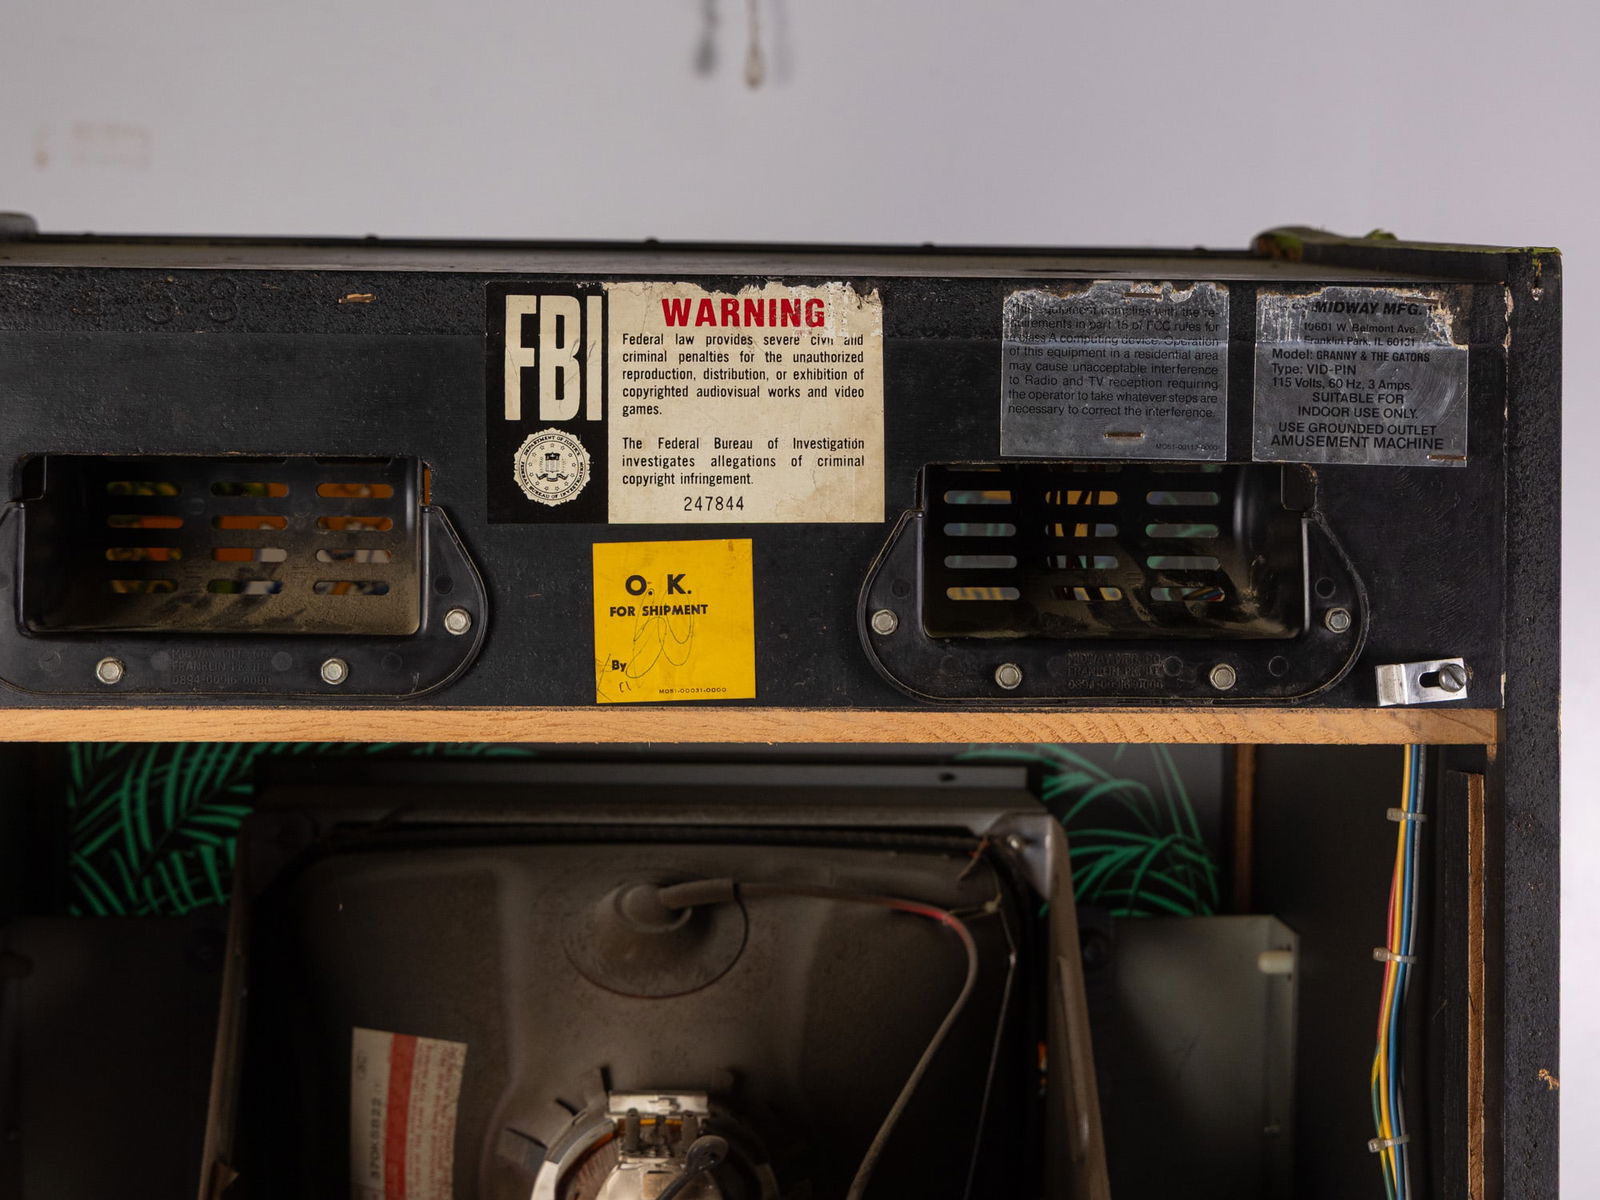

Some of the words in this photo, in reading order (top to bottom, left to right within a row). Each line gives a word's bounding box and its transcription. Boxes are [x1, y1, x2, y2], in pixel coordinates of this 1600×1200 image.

[662, 298, 825, 327] WARNING
[1314, 301, 1378, 315] MIDWAY
[1383, 302, 1423, 316] MFG.
[1076, 320, 1086, 329] in
[1090, 320, 1111, 331] part
[1133, 321, 1144, 330] of
[1147, 322, 1170, 331] FCC
[1175, 322, 1201, 331] rules
[1205, 323, 1218, 331] for
[1337, 323, 1348, 332] W.
[1352, 324, 1393, 333] Belmont
[1398, 325, 1418, 334] Ave.
[622, 333, 663, 346] Federal
[675, 333, 694, 346] law
[706, 333, 753, 349] provides
[764, 336, 799, 346] severe
[1049, 334, 1057, 343] A
[1060, 336, 1118, 346] computing
[1374, 337, 1383, 346] IL
[505, 295, 603, 421] FBI
[622, 351, 666, 364] criminal
[679, 351, 729, 366] penalties
[740, 351, 754, 364] for
[765, 351, 782, 364] the
[793, 351, 864, 364] unauthorized
[1009, 348, 1021, 356] of
[1024, 348, 1043, 356] this
[1047, 349, 1106, 359] equipment
[1110, 350, 1119, 358] in
[1135, 349, 1191, 359] residential
[1195, 352, 1218, 360] area
[1272, 349, 1313, 360] Model:
[1317, 352, 1357, 361] GRANNY
[1361, 352, 1367, 361] &
[1372, 352, 1389, 361] THE
[1392, 353, 1430, 362] GATORS
[622, 368, 696, 383] reproduction,
[703, 368, 769, 383] distribution,
[776, 371, 786, 381] or
[793, 368, 847, 381] exhibition
[853, 368, 864, 381] of
[1009, 363, 1031, 373] may
[1036, 363, 1068, 372] cause
[1073, 363, 1147, 374] unacceptable
[1151, 365, 1218, 374] interference
[1272, 364, 1303, 375] Type:
[1307, 364, 1356, 375] VID-PIN
[1009, 376, 1019, 384] to
[1026, 376, 1057, 386] Radio
[1063, 376, 1083, 386] and
[1089, 377, 1104, 386] TV
[1109, 377, 1162, 389] reception
[1167, 379, 1218, 391] requiring
[1272, 377, 1291, 387] 115
[1295, 378, 1325, 389] Volts,
[1329, 379, 1342, 388] 60
[1346, 380, 1364, 390] Hz,
[1369, 380, 1375, 389] 3
[1378, 381, 1412, 391] Amps.
[622, 386, 688, 400] copyrighted
[697, 386, 760, 398] audiovisual
[768, 386, 800, 398] works
[807, 386, 827, 398] and
[835, 386, 864, 398] video
[1009, 390, 1025, 399] the
[1029, 391, 1074, 402] operator
[1077, 392, 1088, 400] to
[1091, 391, 1113, 401] take
[1117, 392, 1167, 402] whatever
[1169, 393, 1197, 404] steps
[1313, 392, 1373, 403] SUITABLE
[1378, 394, 1404, 403] FOR
[622, 405, 662, 418] games.
[1009, 405, 1064, 415] necessary
[1068, 405, 1078, 414] to
[1082, 406, 1120, 415] correct
[1125, 406, 1141, 416] the
[1145, 407, 1215, 418] interference.
[1298, 407, 1349, 417] INDOOR
[1354, 408, 1379, 418] USE
[1384, 409, 1418, 419] ONLY.
[1279, 423, 1304, 432] USE
[1309, 424, 1384, 434] GROUNDED
[1388, 425, 1437, 435] OUTLET
[622, 437, 642, 449] The
[658, 437, 699, 449] Federal
[714, 437, 753, 449] Bureau
[767, 437, 778, 449] of
[793, 437, 864, 452] Investigation
[1271, 435, 1369, 448] AMUSEMENT
[1374, 437, 1444, 449] MACHINE
[622, 455, 695, 470] investigates
[711, 455, 775, 470] allegations
[791, 455, 802, 467] of
[818, 455, 864, 467] criminal
[622, 472, 675, 487] copyright
[680, 472, 753, 487] infringement.
[684, 496, 744, 511] 247844
[625, 574, 653, 595] O.
[667, 574, 691, 595] K.
[610, 607, 635, 617] FOR
[642, 604, 708, 616] SHIPMENT
[612, 660, 627, 672] By
